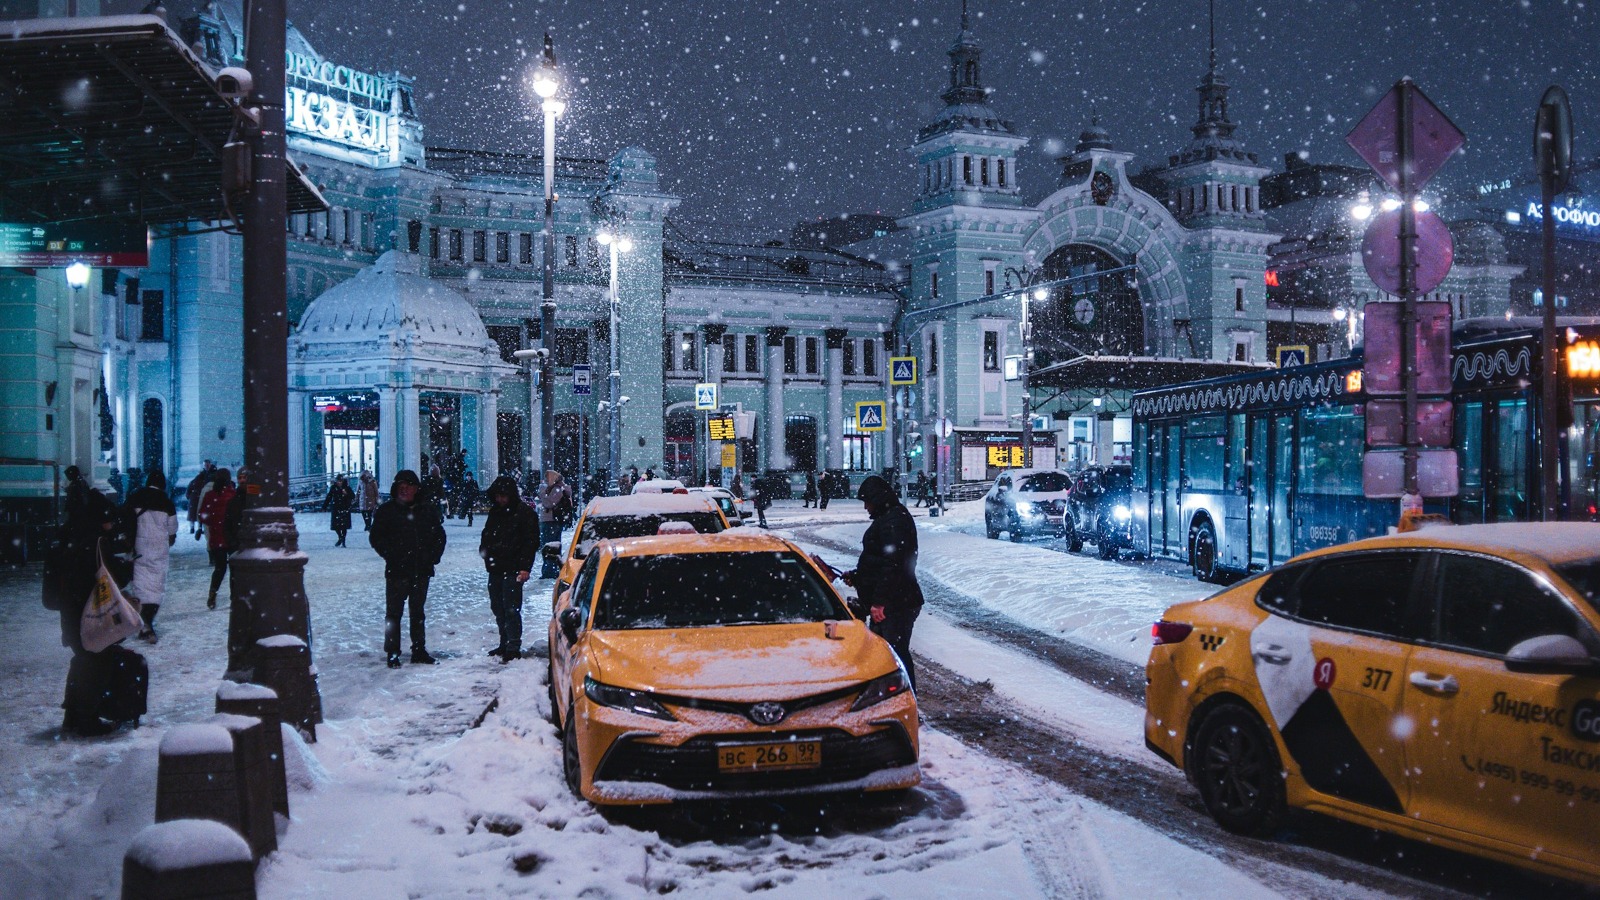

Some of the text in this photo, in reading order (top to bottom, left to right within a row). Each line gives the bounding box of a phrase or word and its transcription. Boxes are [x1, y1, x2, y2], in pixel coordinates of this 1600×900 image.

[1527, 201, 1600, 226] АЭОФЛО
[50, 241, 82, 249] D1 D4
[1362, 667, 1394, 692] 377
[1491, 690, 1567, 727] Яндекс
[725, 743, 815, 765] ВС 266 99
[1540, 735, 1600, 773] Такси
[1478, 757, 1518, 783] (495)
